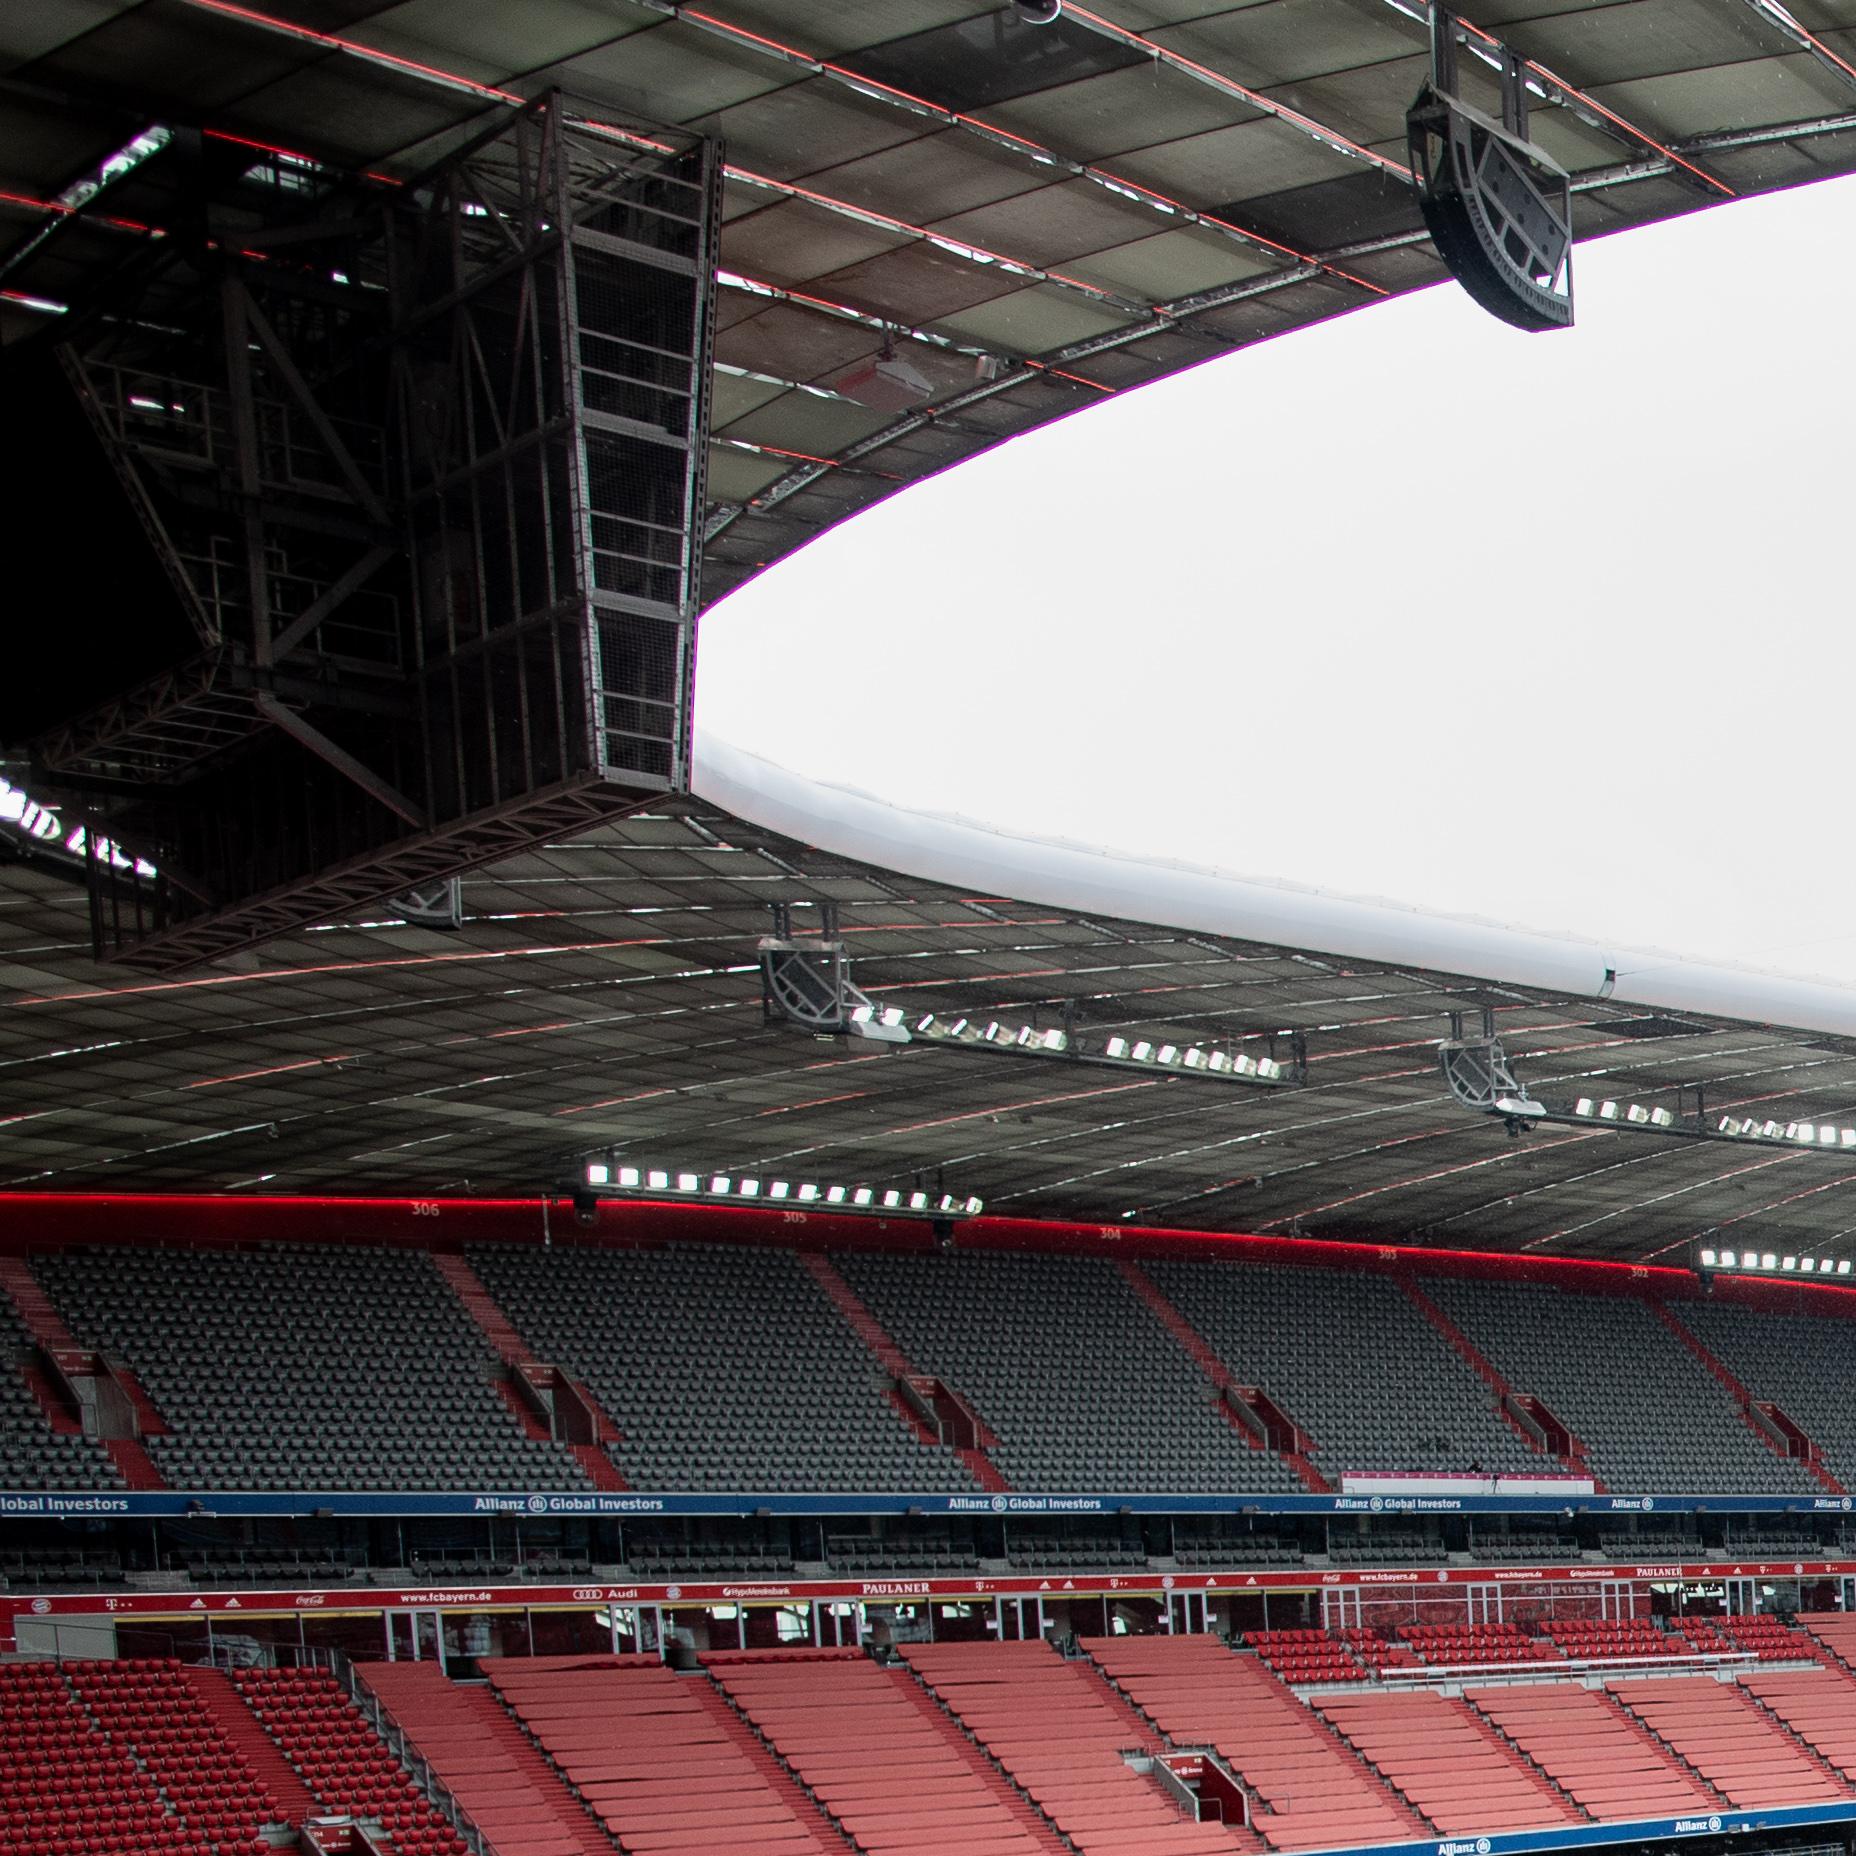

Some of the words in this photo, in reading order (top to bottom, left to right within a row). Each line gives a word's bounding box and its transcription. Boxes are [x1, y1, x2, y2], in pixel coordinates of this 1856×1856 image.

[411, 1202, 440, 1217] 306
[783, 1211, 807, 1224] 305
[1099, 1228, 1122, 1241] 304
[0, 1497, 42, 1512] lobal
[47, 1497, 129, 1512] Investors
[474, 1498, 527, 1512] Allianz
[550, 1497, 594, 1511] Global
[598, 1497, 663, 1511] Investors
[949, 1498, 991, 1511] Allianz
[1012, 1497, 1045, 1510] Global
[1047, 1497, 1101, 1510] Investors
[1334, 1498, 1370, 1510] Allianz
[1385, 1498, 1415, 1510] Global
[1417, 1498, 1462, 1510] Investors
[1611, 1498, 1641, 1510] Allianz
[400, 1590, 492, 1604] www.fcbayern.de
[607, 1590, 638, 1599] Audi
[862, 1582, 930, 1595] PAULANER
[1636, 1567, 1682, 1578] PAULANER
[1675, 1818, 1708, 1833] Allianz
[1438, 1841, 1475, 1856] Allianz
